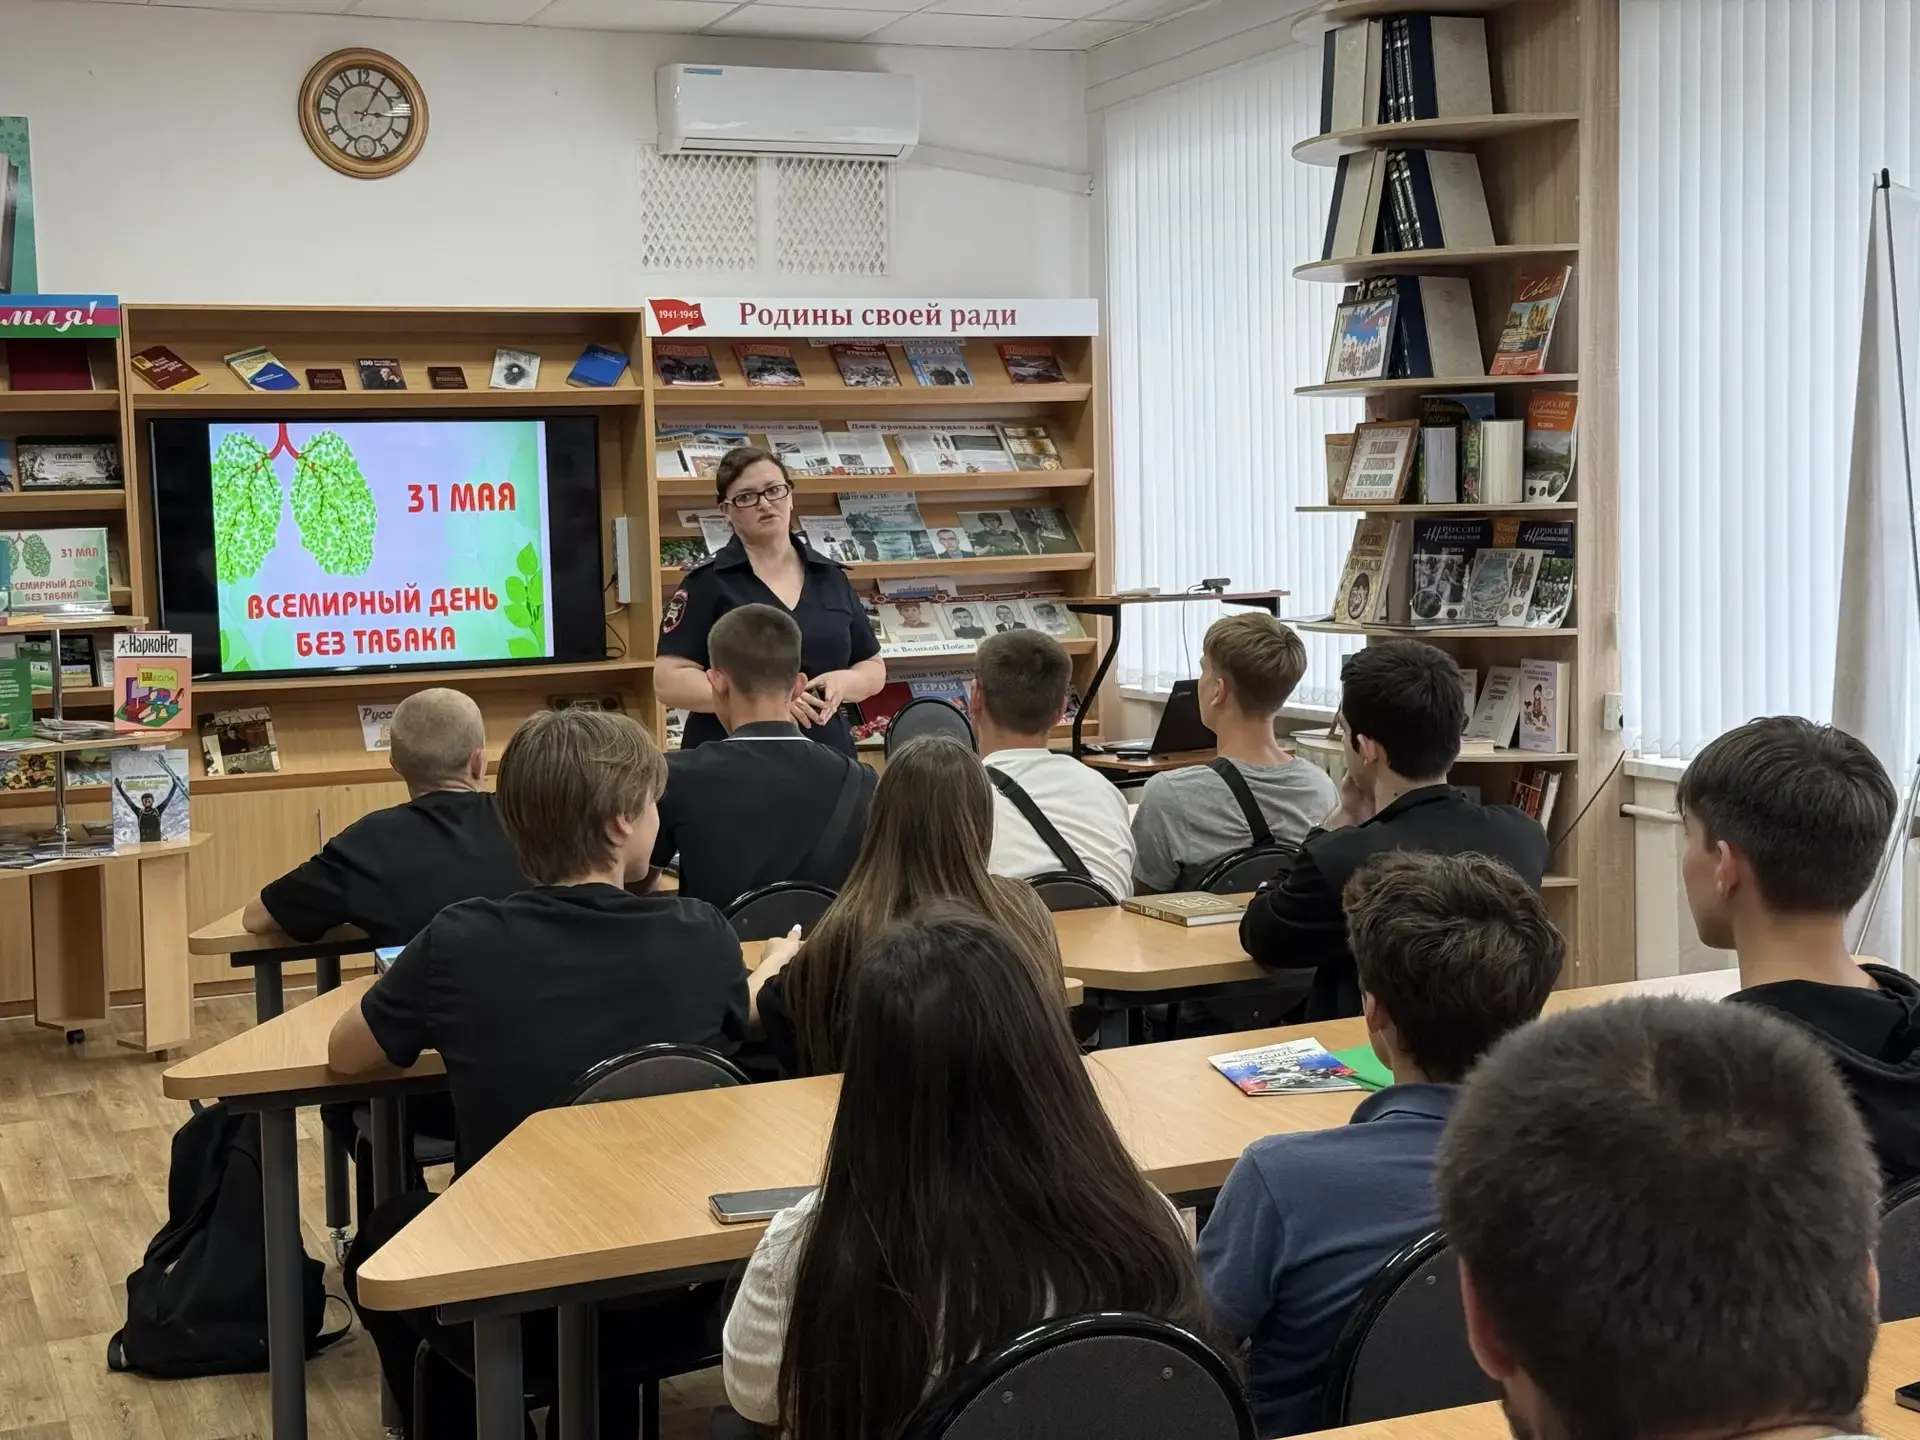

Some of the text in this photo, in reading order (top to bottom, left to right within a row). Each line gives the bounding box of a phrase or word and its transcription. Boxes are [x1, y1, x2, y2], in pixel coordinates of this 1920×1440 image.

[658, 310, 699, 320] 1941-1945
[739, 302, 1018, 333] Родины своей ради
[407, 481, 516, 513] 31 МАЯ
[60, 547, 99, 558] 31 МАЯ
[69, 578, 94, 589] ДЕНЬ
[24, 591, 79, 602] БЕЗ ТАБАКА
[247, 582, 499, 620] ВСЕМИРНЫЙ ДЕНЬ
[129, 634, 178, 656] НаркоНет
[296, 625, 457, 657] БЕЗ ТАБАКА
[901, 644, 940, 653] Великой
[942, 642, 976, 652] Победе
[914, 681, 960, 693] ГЕРОИ
[361, 707, 395, 723] Русс
